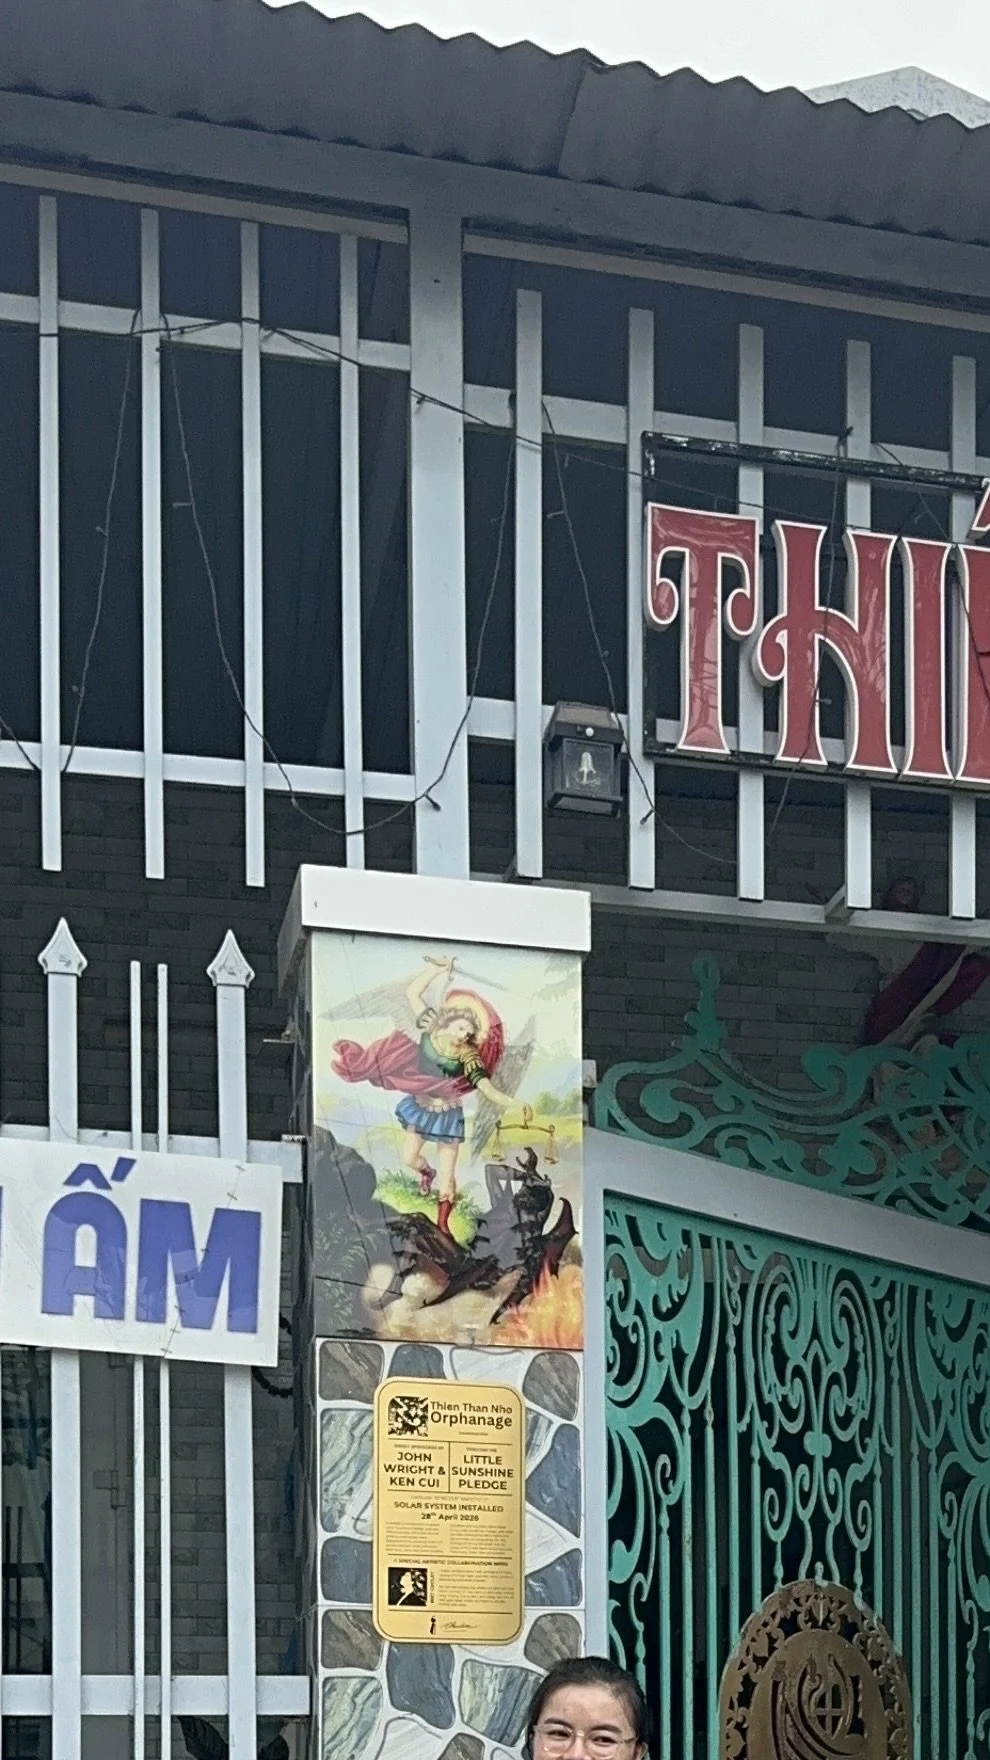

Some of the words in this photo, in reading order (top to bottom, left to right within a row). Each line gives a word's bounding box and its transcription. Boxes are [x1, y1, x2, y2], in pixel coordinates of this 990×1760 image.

[41, 1157, 262, 1334] ẤM
[431, 1401, 460, 1411] Thien
[463, 1403, 488, 1413] Than
[491, 1405, 512, 1414] Nho
[431, 1411, 513, 1429] Orphanage
[397, 1452, 432, 1462] JOHN
[463, 1455, 503, 1465] LITTLE
[384, 1464, 435, 1475] WRIGHT
[438, 1466, 446, 1475] &
[452, 1466, 514, 1478] SUNSHINE
[390, 1477, 415, 1487] KEN
[418, 1478, 440, 1488] CUI
[459, 1479, 507, 1490] PLEDGE
[394, 1501, 422, 1509] SOLAR
[424, 1503, 457, 1511] SYSTEM
[459, 1504, 504, 1512] INSTALLED
[438, 1513, 458, 1522] April
